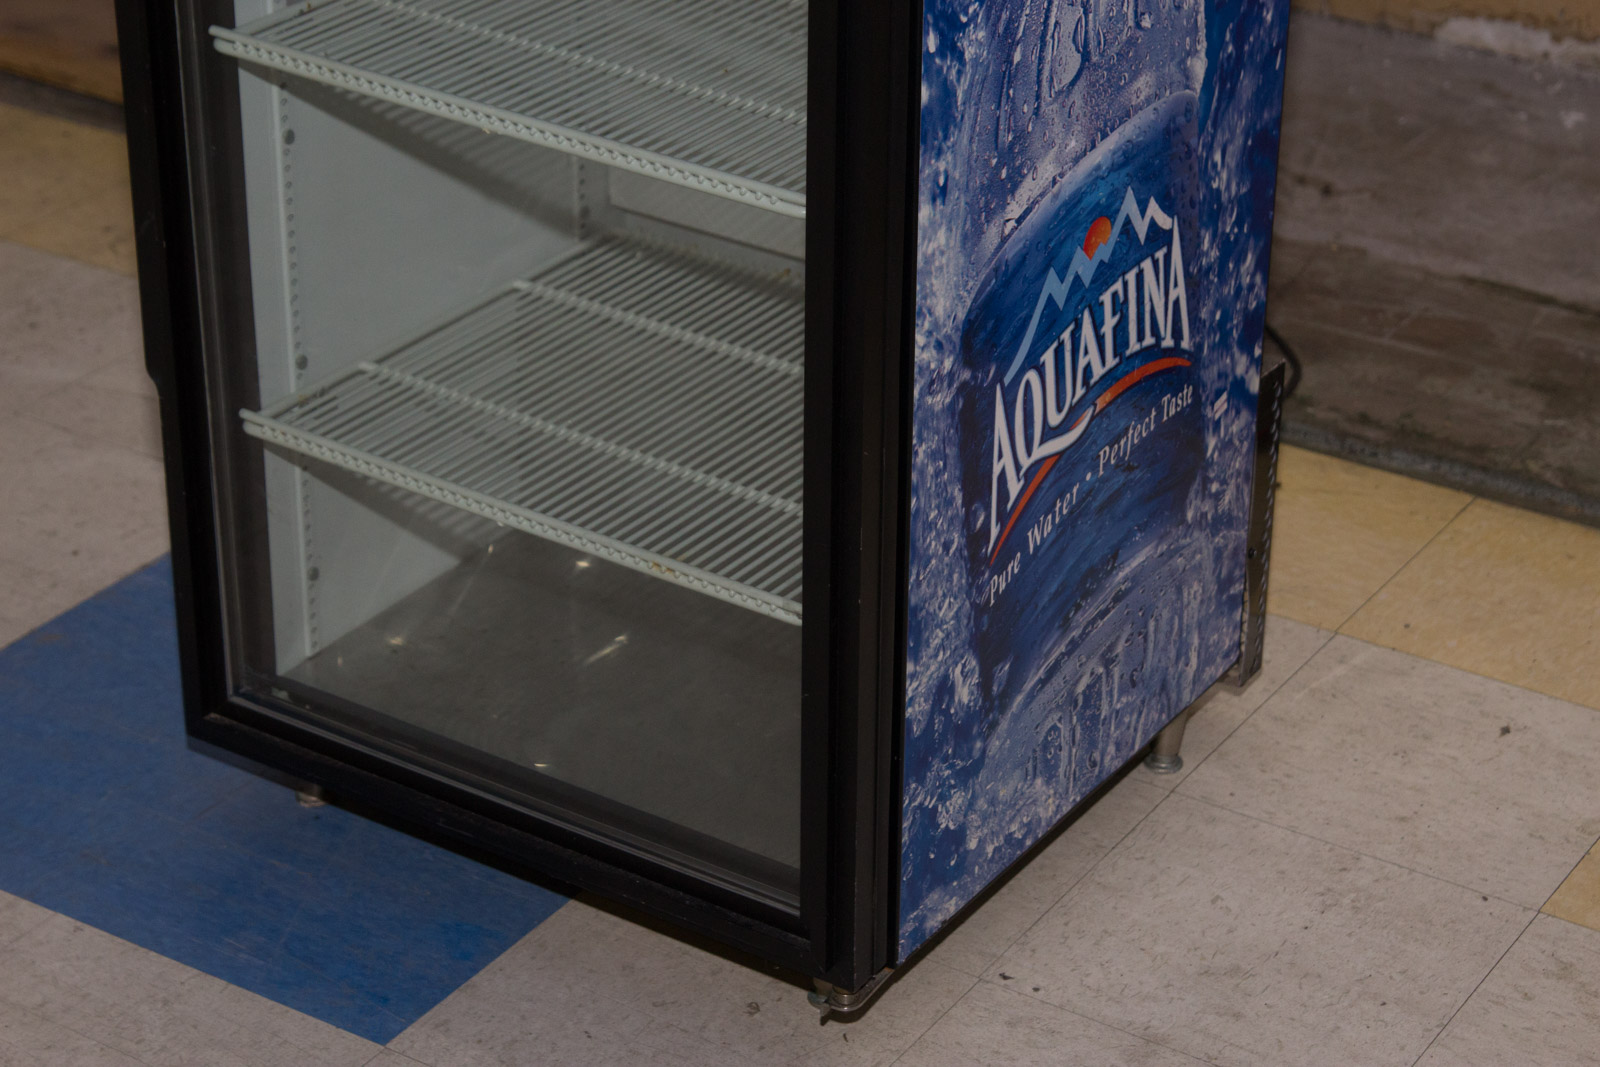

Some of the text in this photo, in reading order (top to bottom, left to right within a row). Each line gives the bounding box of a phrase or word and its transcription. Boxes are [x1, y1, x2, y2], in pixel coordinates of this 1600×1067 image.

[987, 214, 1191, 557] AQUAFINA
[989, 383, 1194, 608] Pure Water Perfect Taste
